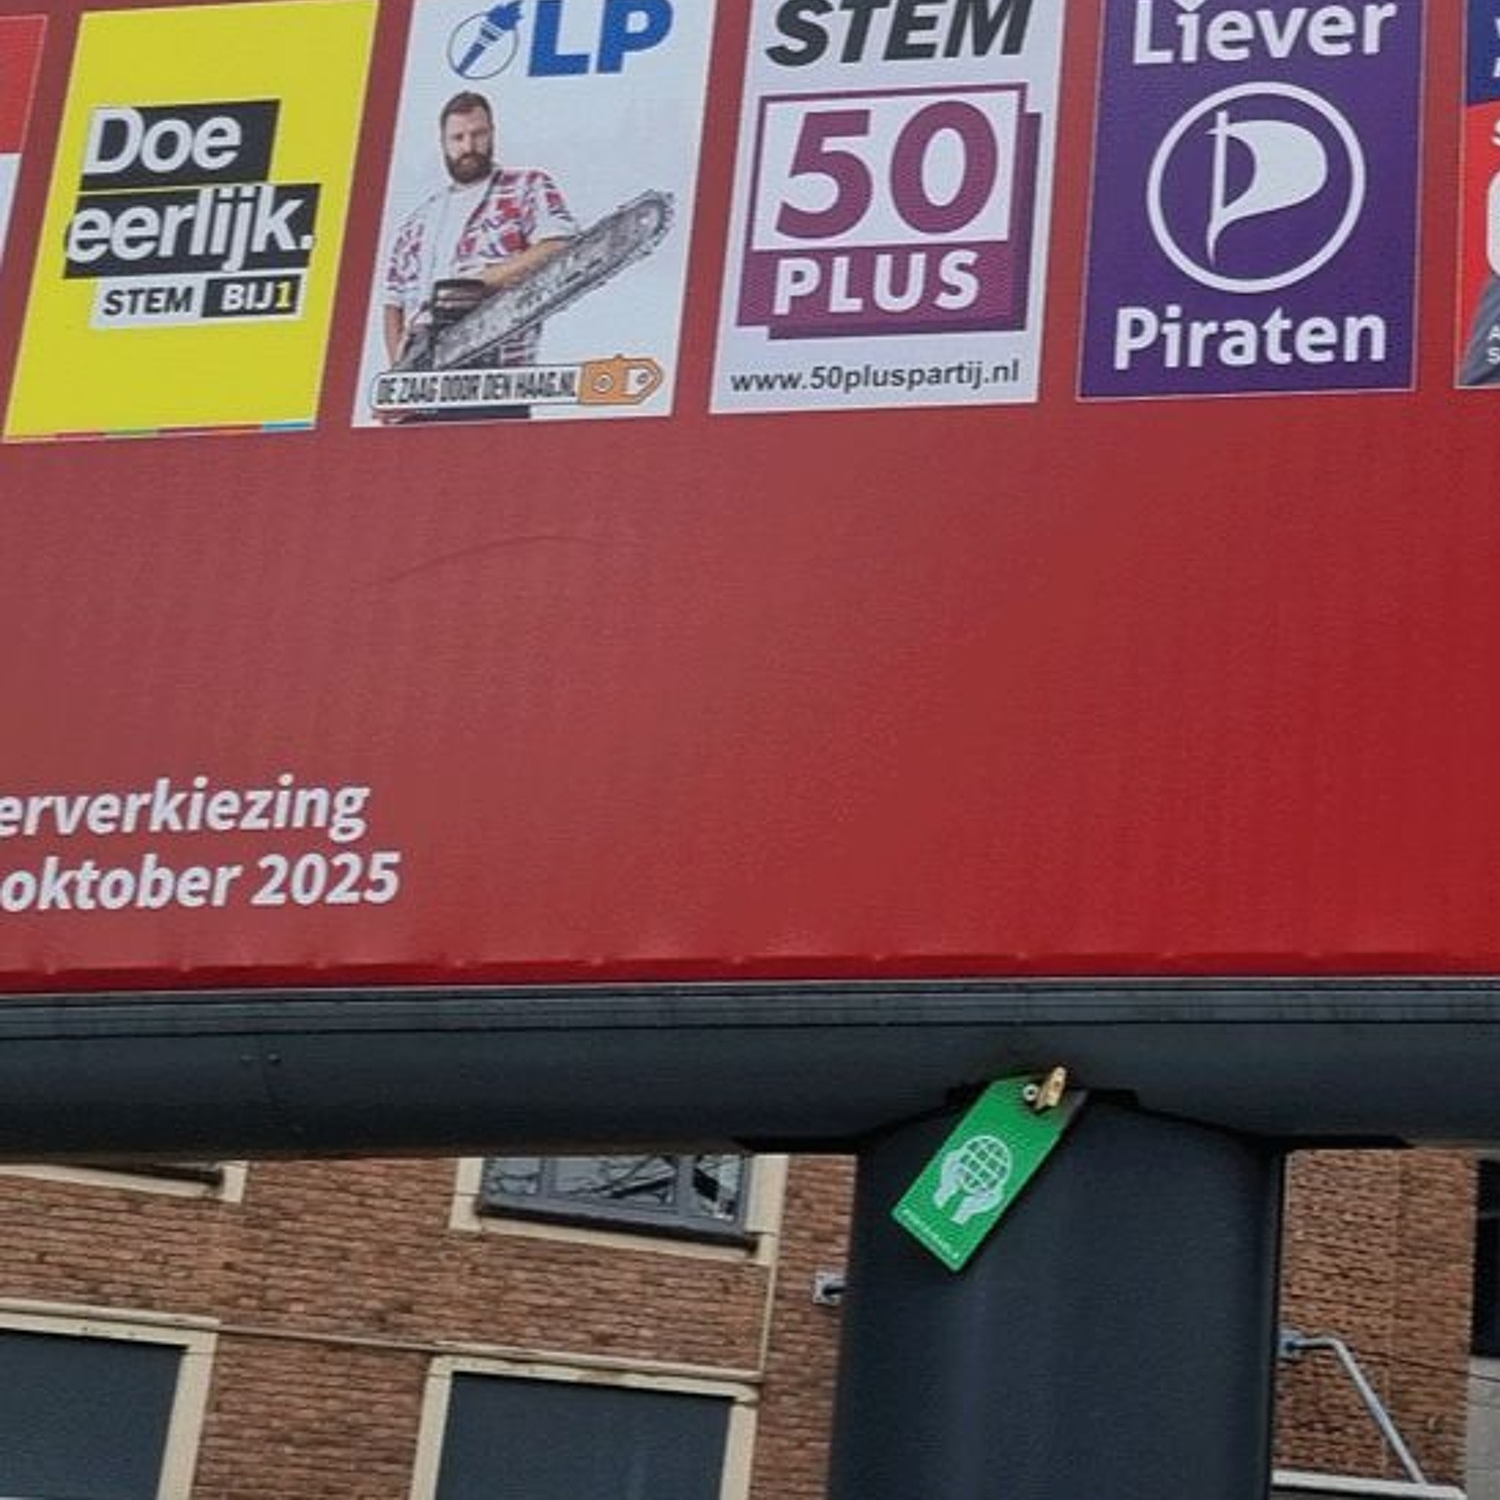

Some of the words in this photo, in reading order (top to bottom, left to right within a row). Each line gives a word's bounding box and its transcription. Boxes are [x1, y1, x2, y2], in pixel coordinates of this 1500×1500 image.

[83, 107, 242, 175] Doe
[774, 99, 1000, 240] 50
[65, 182, 314, 271] eerlijk.
[103, 286, 193, 317] STEM
[772, 249, 980, 317] PLUS
[1112, 304, 1387, 371] Piraten
[730, 358, 1020, 394] www.50pluspartij.nl
[0, 853, 244, 913] oktober
[251, 851, 402, 906] 2025
